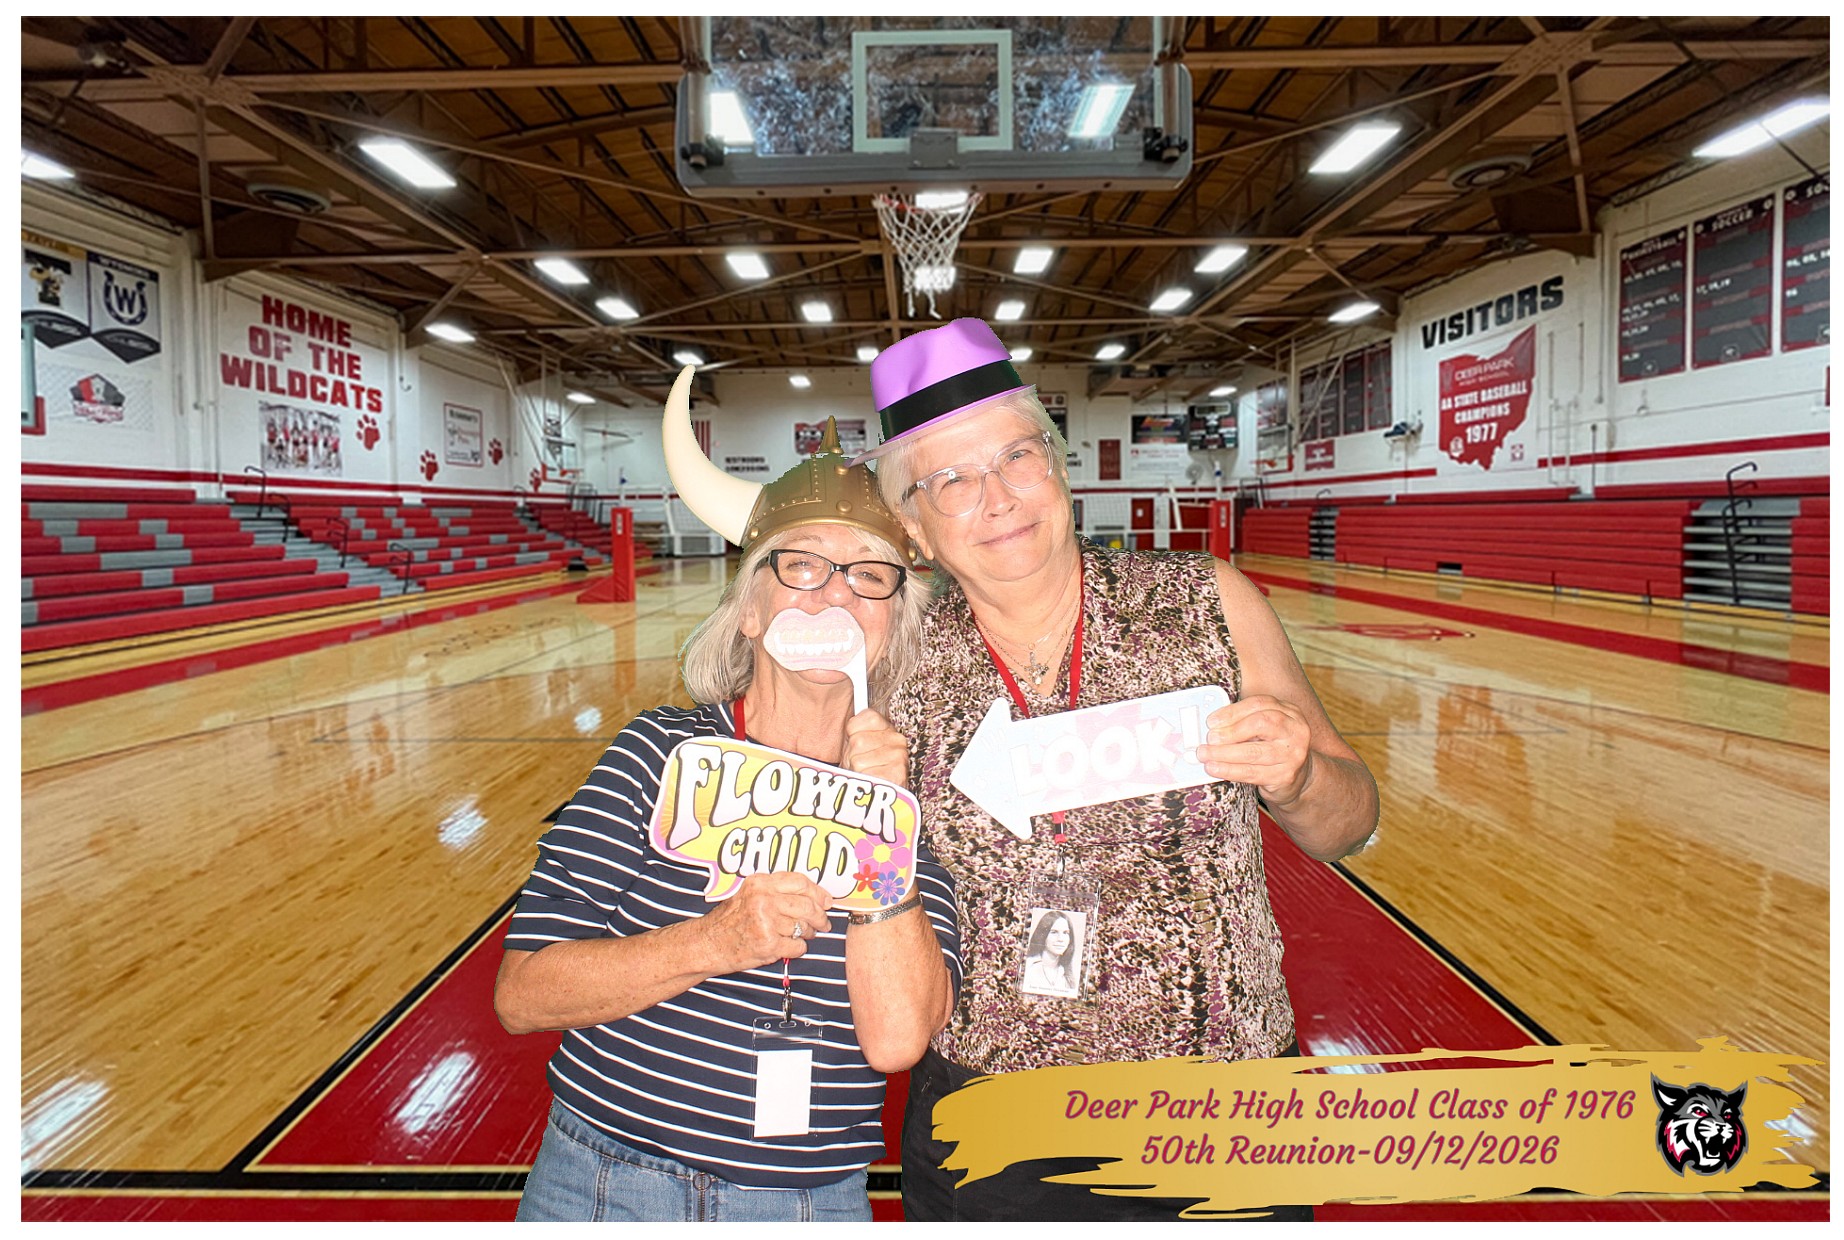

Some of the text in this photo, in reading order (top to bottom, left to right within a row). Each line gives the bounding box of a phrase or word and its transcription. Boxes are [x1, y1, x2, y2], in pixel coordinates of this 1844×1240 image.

[1711, 208, 1754, 232] SOCCER
[113, 284, 137, 315] W
[1421, 275, 1564, 350] VISITORS
[261, 294, 352, 349] HOME
[248, 325, 362, 381] OF THE
[1483, 356, 1515, 373] PARK
[220, 352, 383, 414] WILDCATS
[1454, 391, 1479, 408] STATE
[1480, 380, 1528, 402] BASEBALL
[1454, 402, 1511, 424] CHAMPIONS
[1465, 422, 1499, 444] 1977
[665, 741, 898, 850] FLOWER
[717, 824, 861, 900] CHILD
